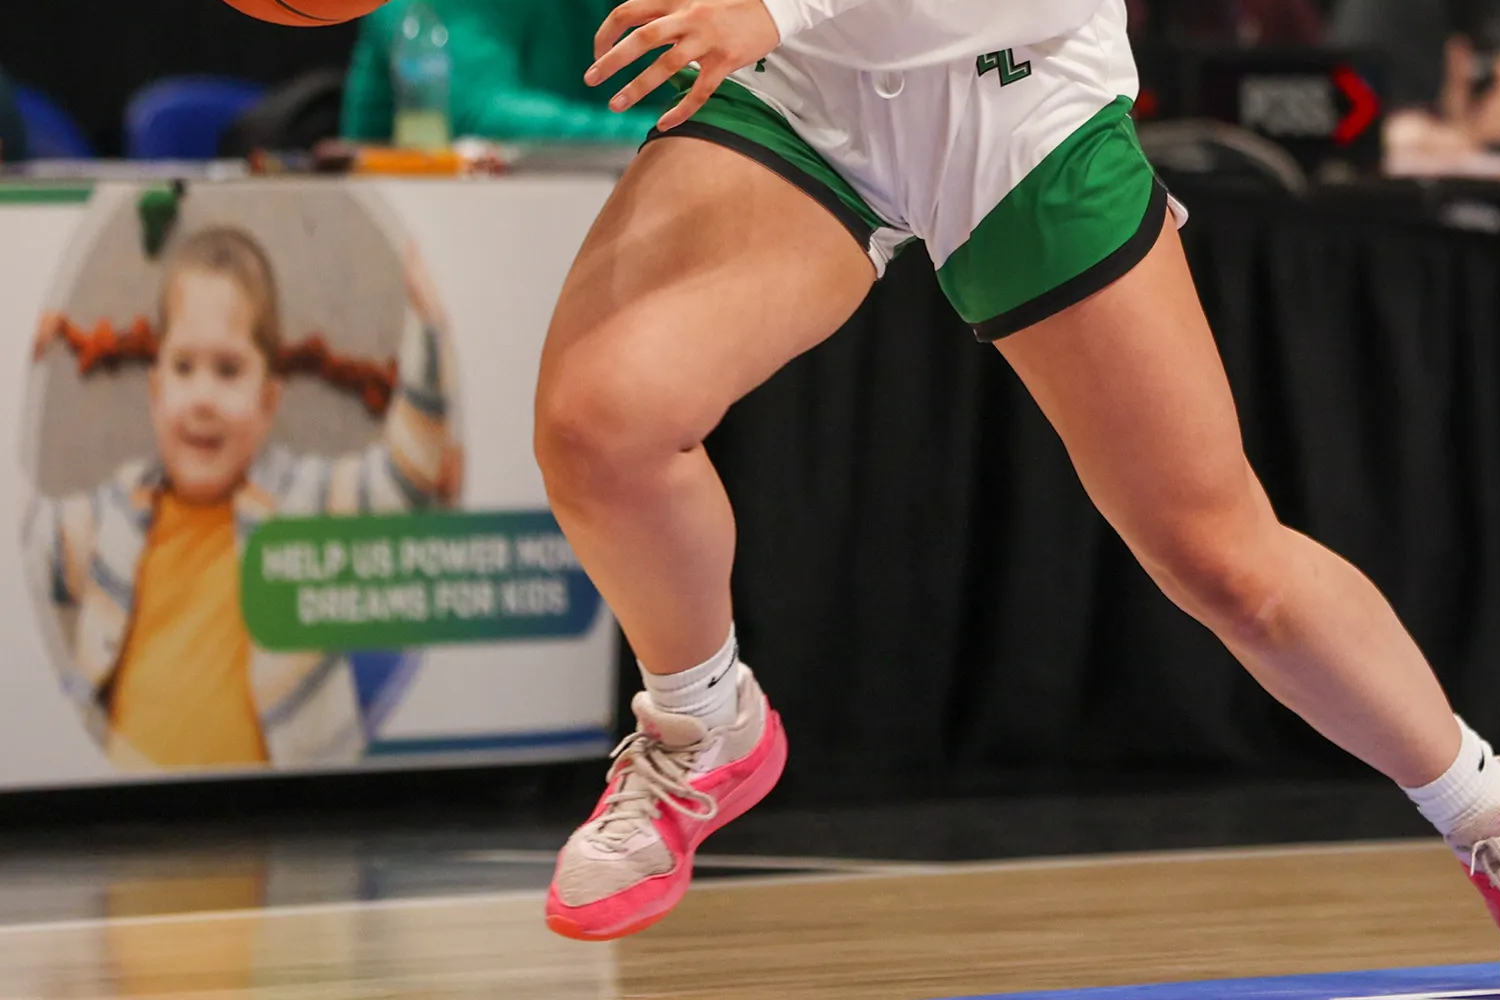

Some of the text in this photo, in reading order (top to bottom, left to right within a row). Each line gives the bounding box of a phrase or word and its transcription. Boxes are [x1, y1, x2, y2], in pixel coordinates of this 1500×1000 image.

[262, 541, 346, 582] HELP
[352, 538, 394, 579] US
[400, 533, 509, 577] POWER
[298, 577, 569, 624] DREAMS FOR KIDS
